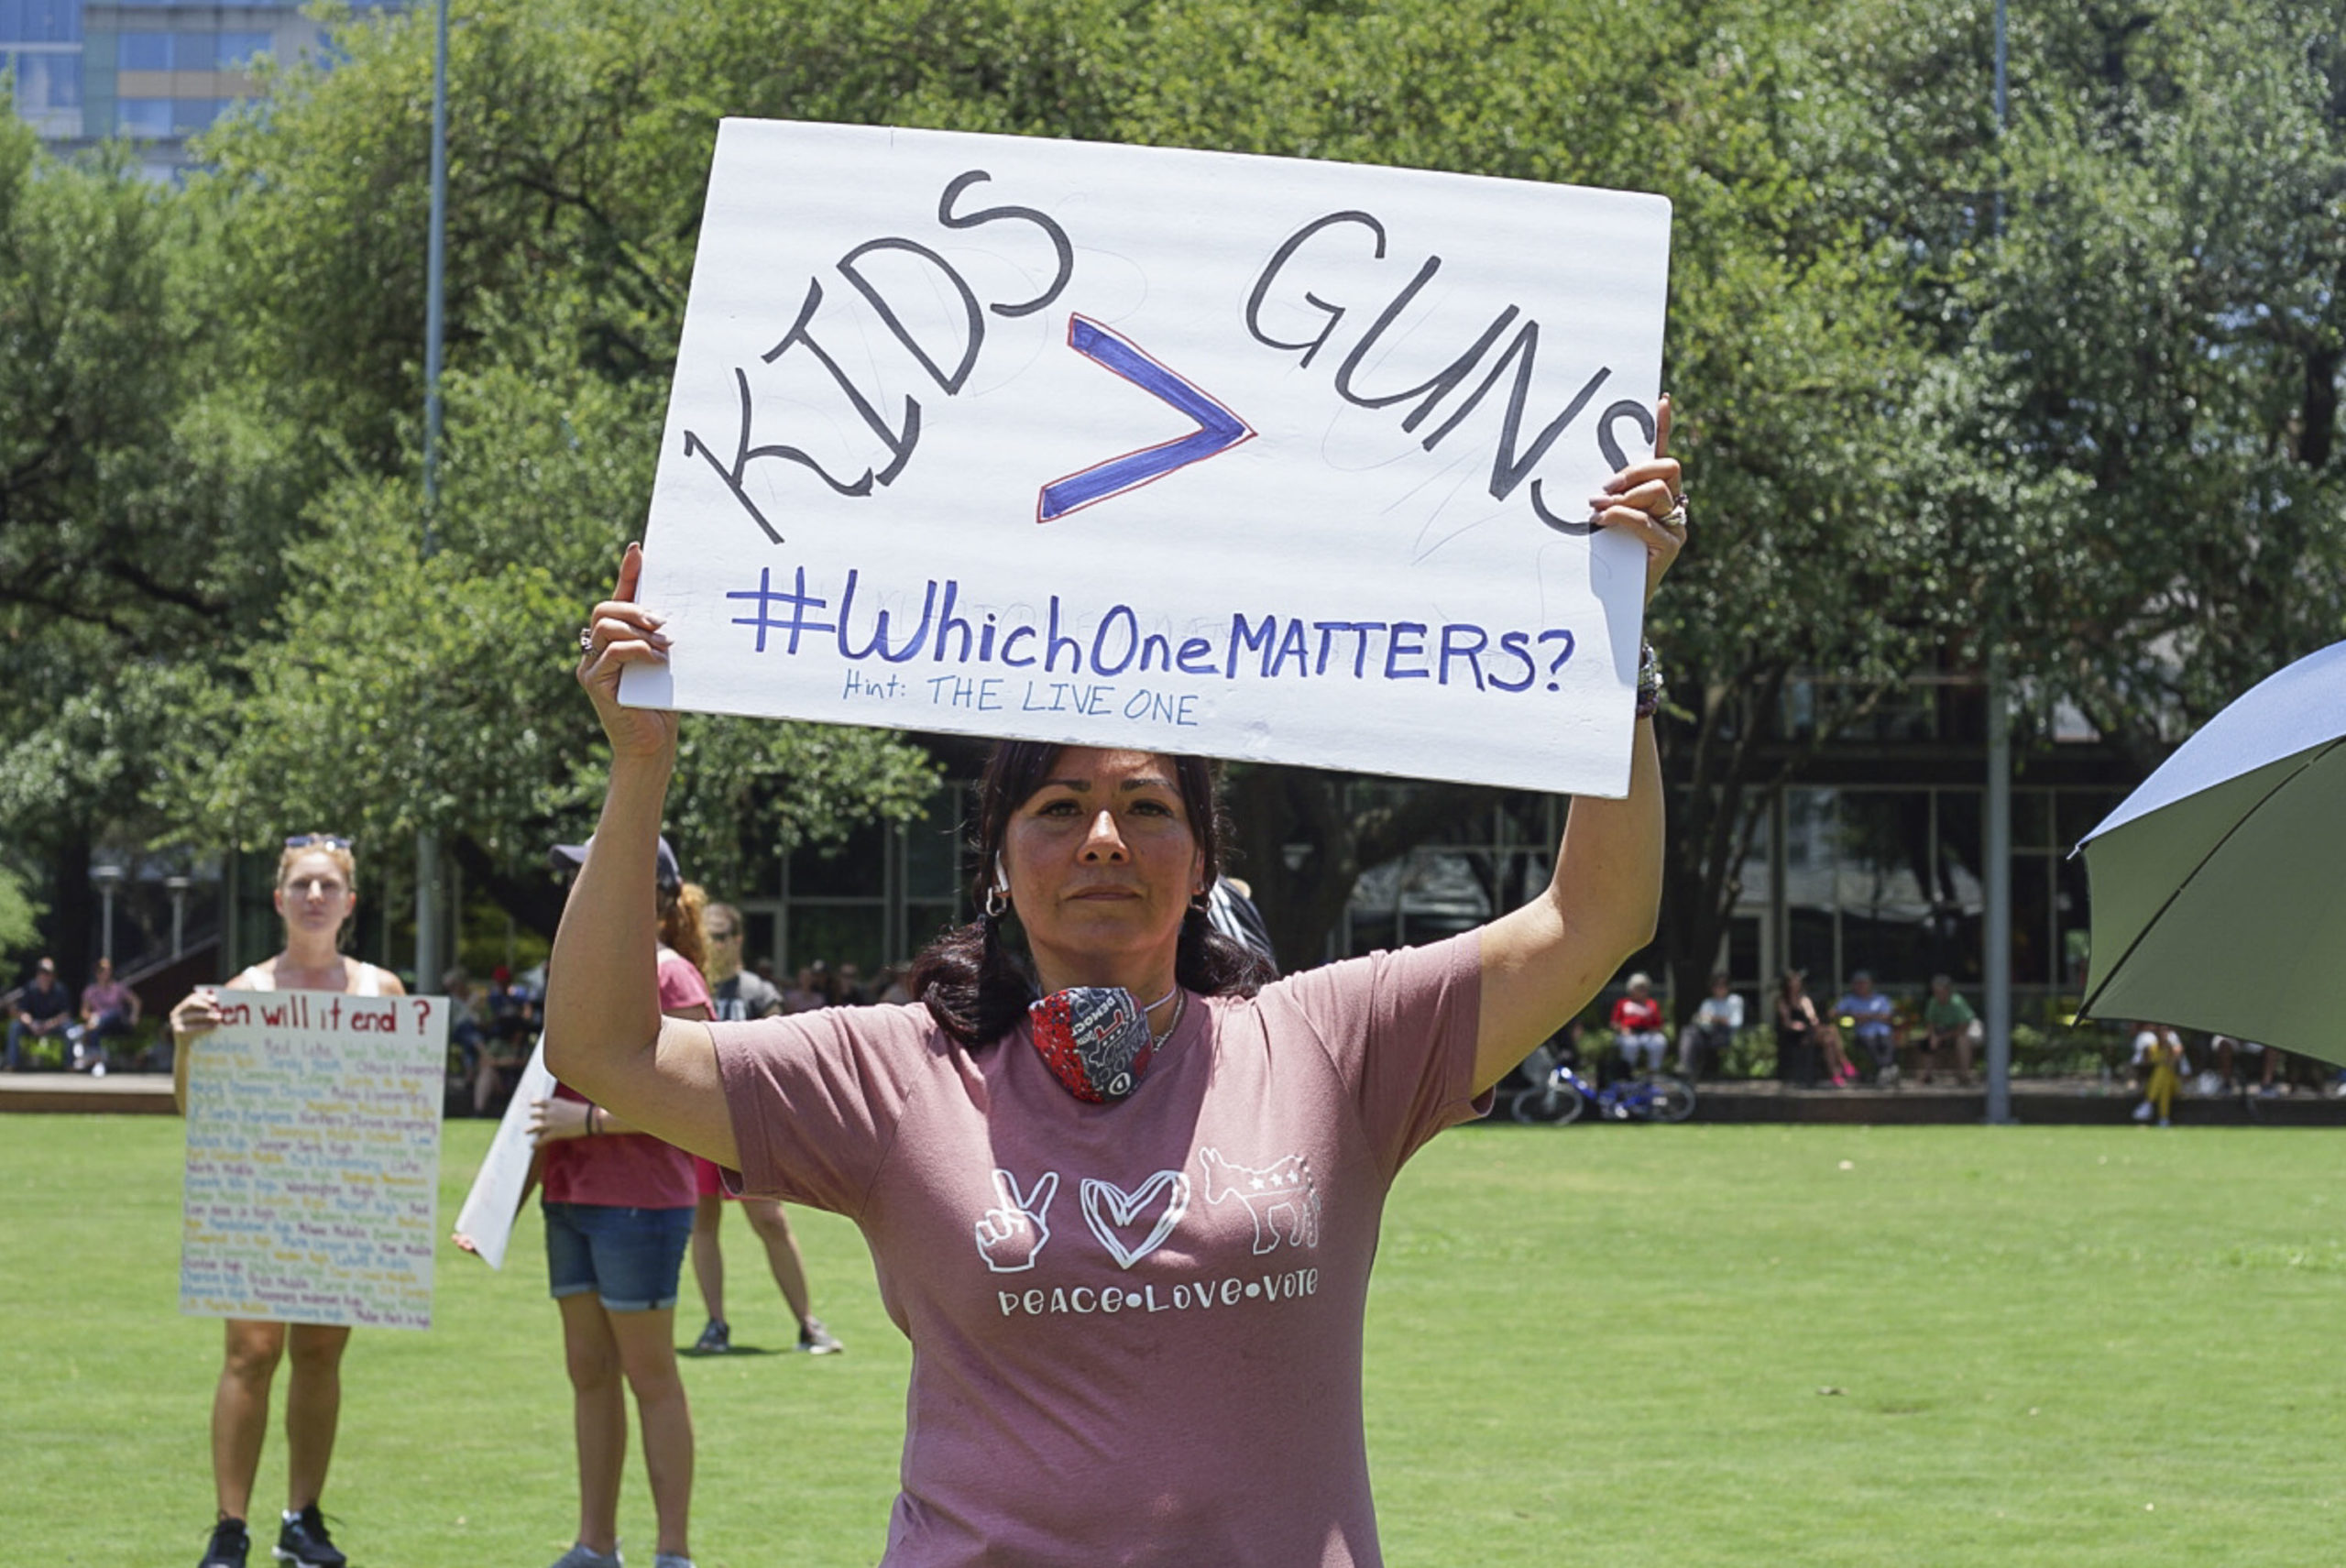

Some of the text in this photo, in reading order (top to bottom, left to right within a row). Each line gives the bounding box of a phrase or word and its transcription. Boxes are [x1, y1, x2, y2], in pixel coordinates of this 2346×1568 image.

[683, 169, 1074, 544] KIDS
[1244, 210, 1655, 536] GUNS
[842, 668, 1200, 727] Hint: THE LIVE ONE
[261, 995, 309, 1029] will
[320, 997, 343, 1031] it
[350, 1001, 398, 1034] end
[412, 999, 432, 1036] ?
